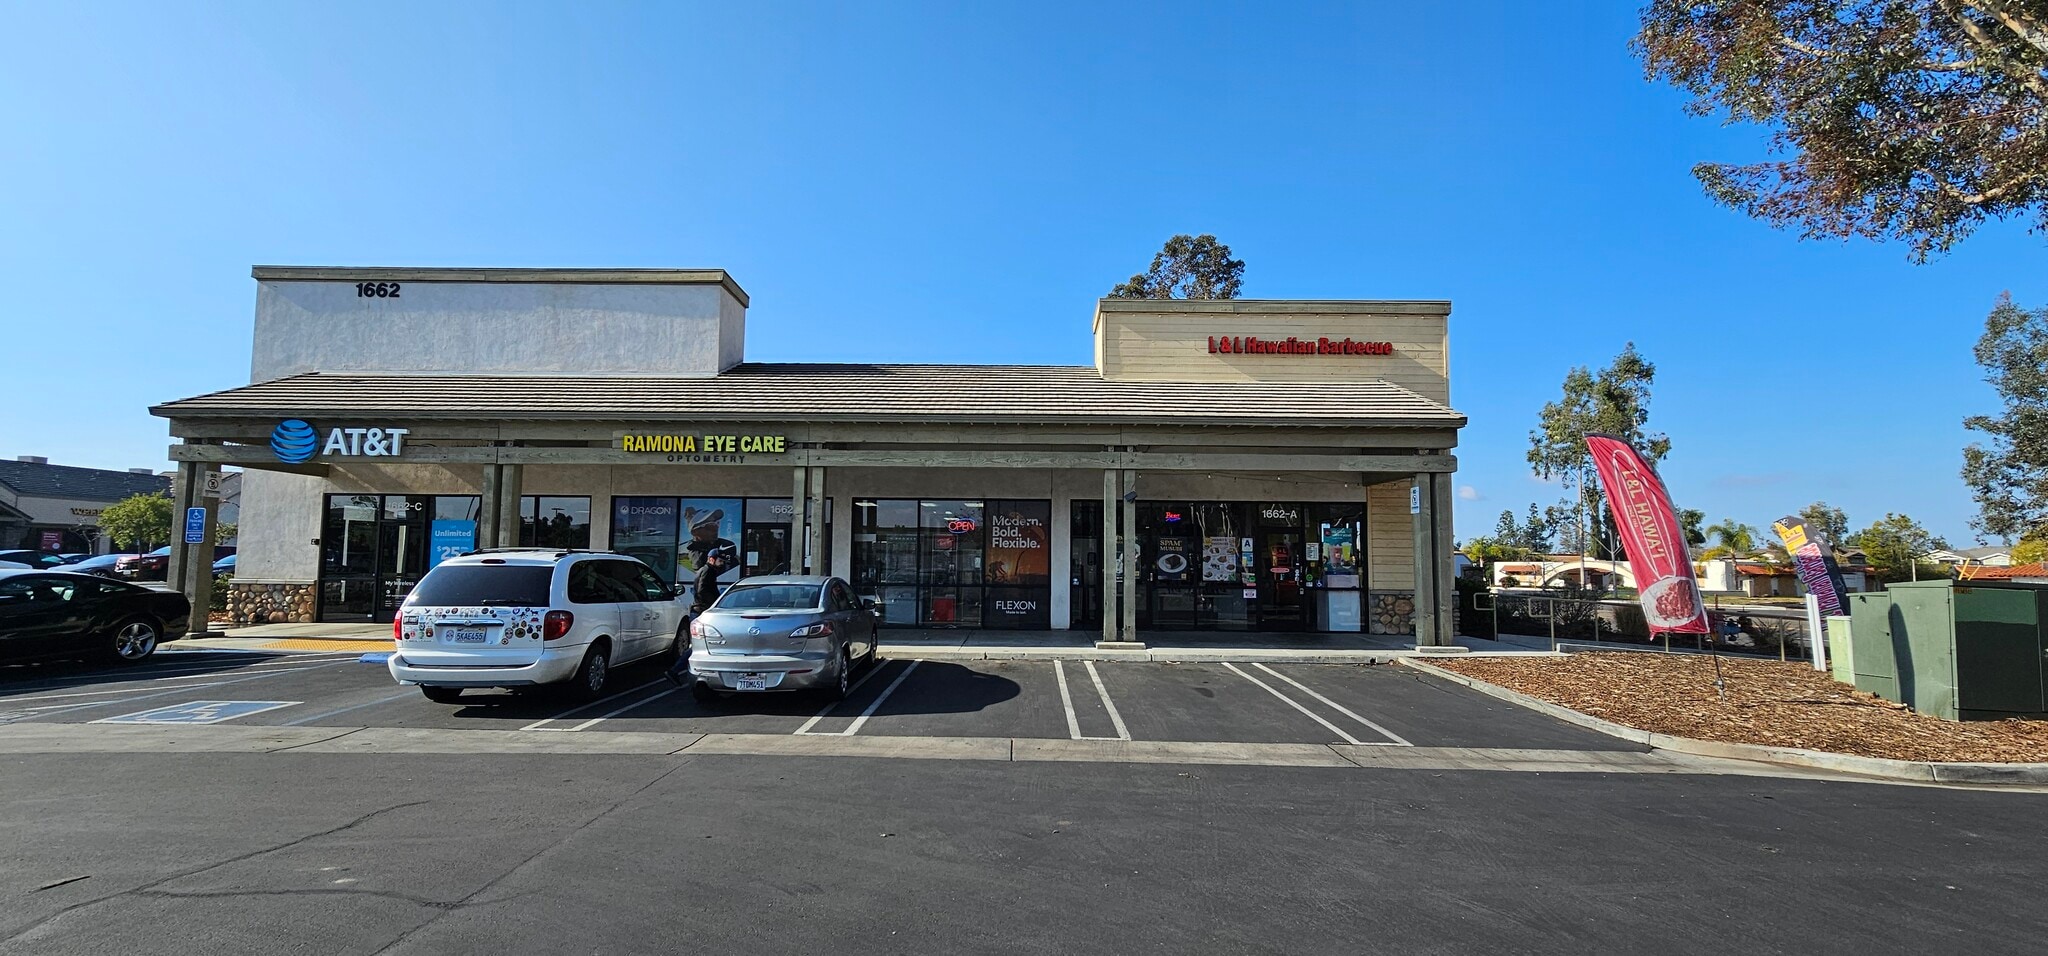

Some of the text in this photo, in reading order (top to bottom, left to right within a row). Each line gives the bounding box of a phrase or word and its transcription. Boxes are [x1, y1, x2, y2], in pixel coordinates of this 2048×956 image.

[356, 282, 400, 298] 1662
[1208, 336, 1392, 355] L & L Hawaiian Barbecue
[322, 427, 410, 457] AT&T
[623, 435, 785, 453] RAMONA EYE CARE
[667, 455, 746, 464] OPTOMETRY
[1622, 470, 1642, 499] L&L
[386, 502, 422, 511] 1662-C
[631, 506, 671, 515] DRAGON
[1165, 511, 1181, 519] Beer
[1262, 509, 1297, 519] 1662-A
[992, 515, 1042, 526] Modern.
[948, 521, 975, 531] OPEN
[992, 526, 1021, 537] Bold.
[992, 537, 1040, 548] Flexible.
[1244, 539, 1251, 547] A
[995, 600, 1036, 610] FLEXON
[456, 632, 483, 640] 5KAE455
